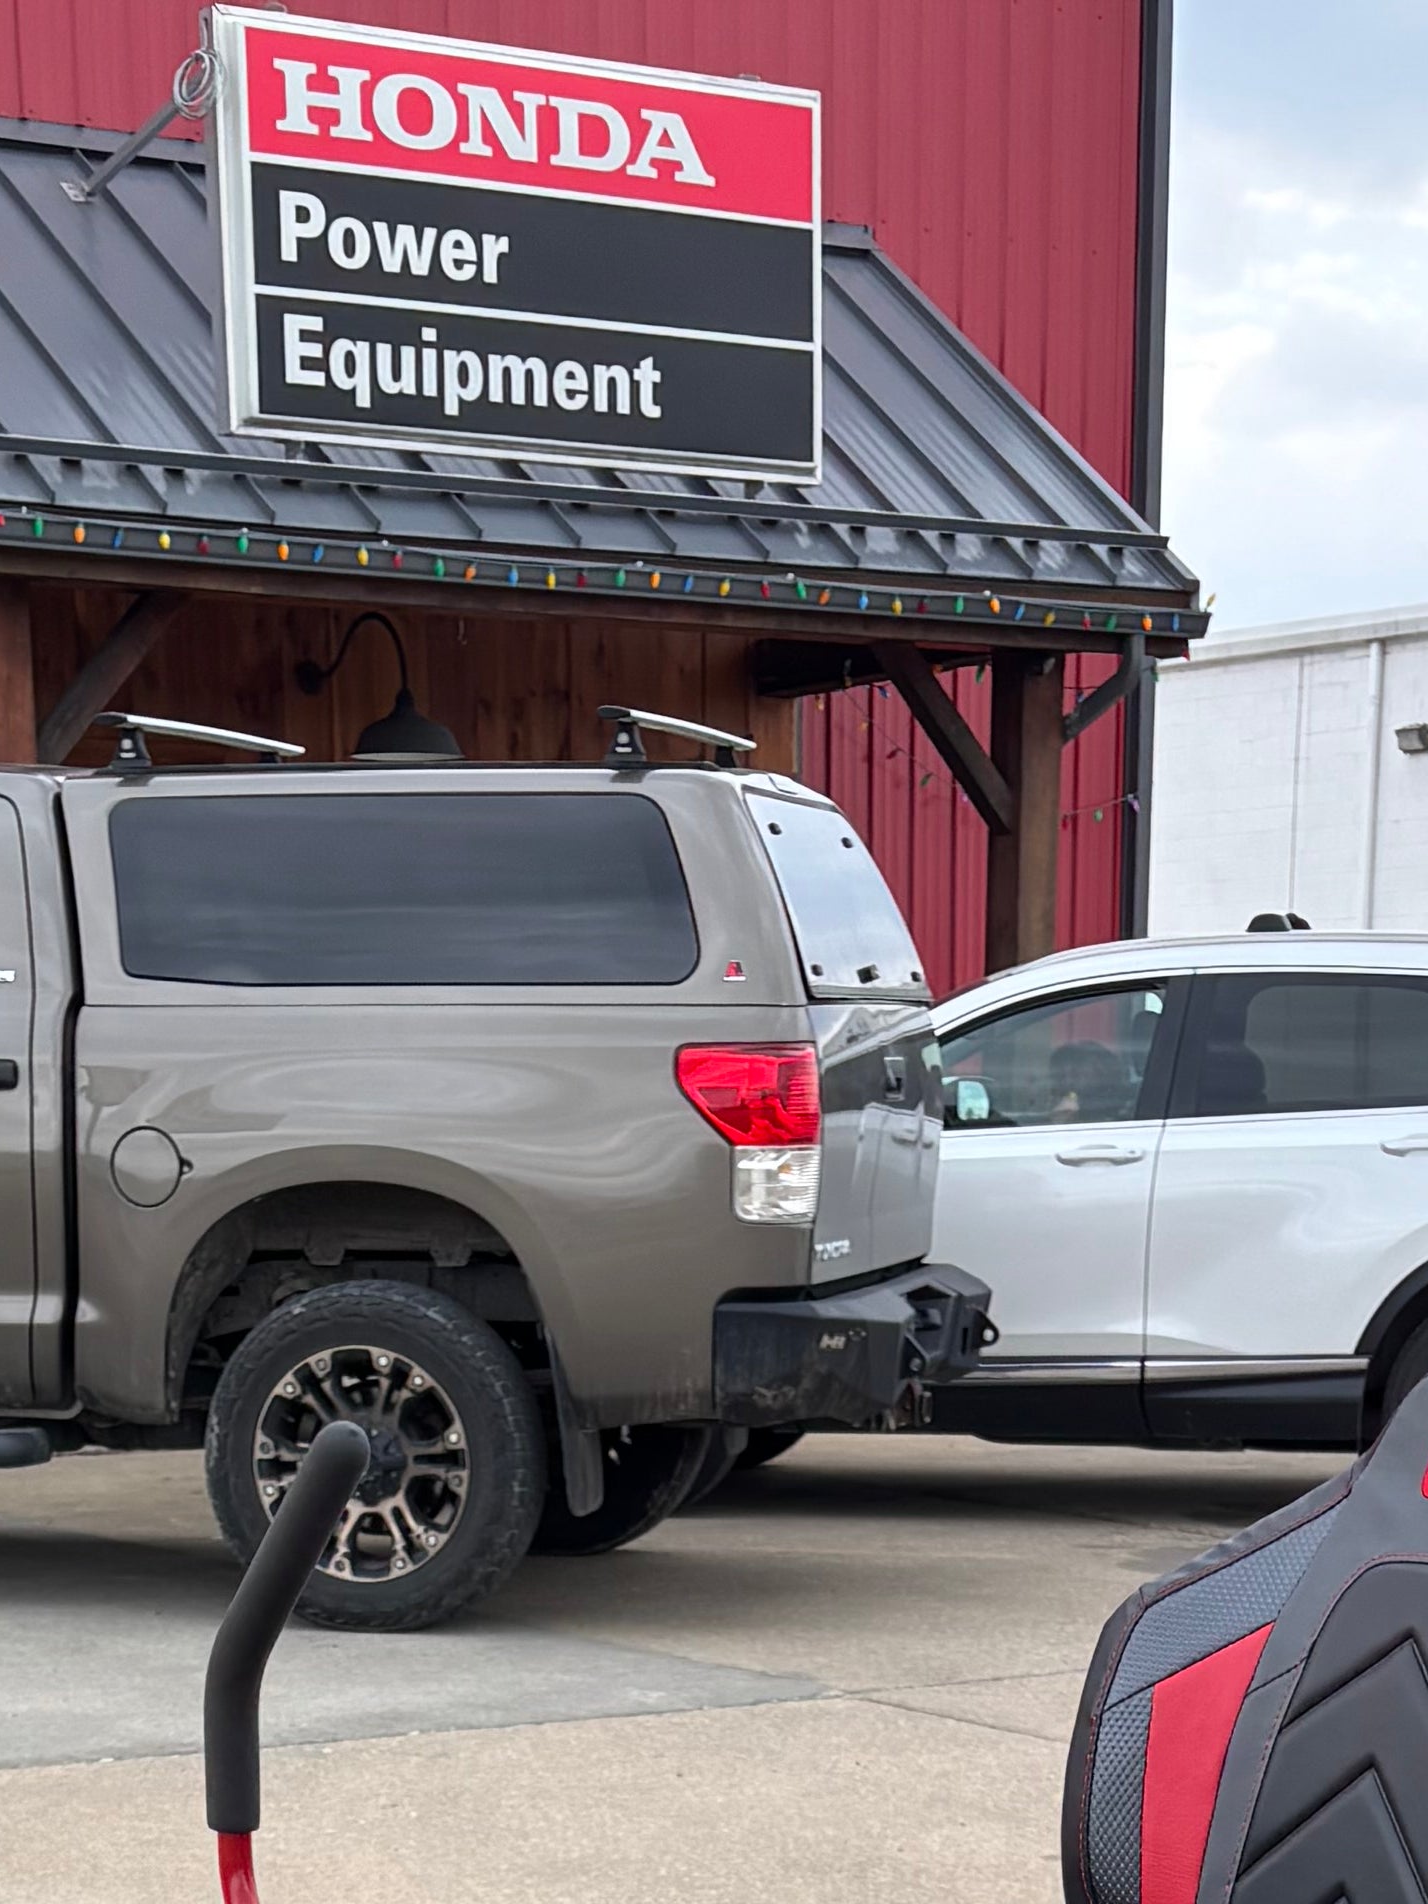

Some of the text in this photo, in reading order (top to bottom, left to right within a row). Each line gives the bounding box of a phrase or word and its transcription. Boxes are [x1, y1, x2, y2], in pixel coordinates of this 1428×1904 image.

[272, 57, 716, 188] HONDA
[278, 190, 510, 284] Power
[282, 312, 662, 419] Equipment
